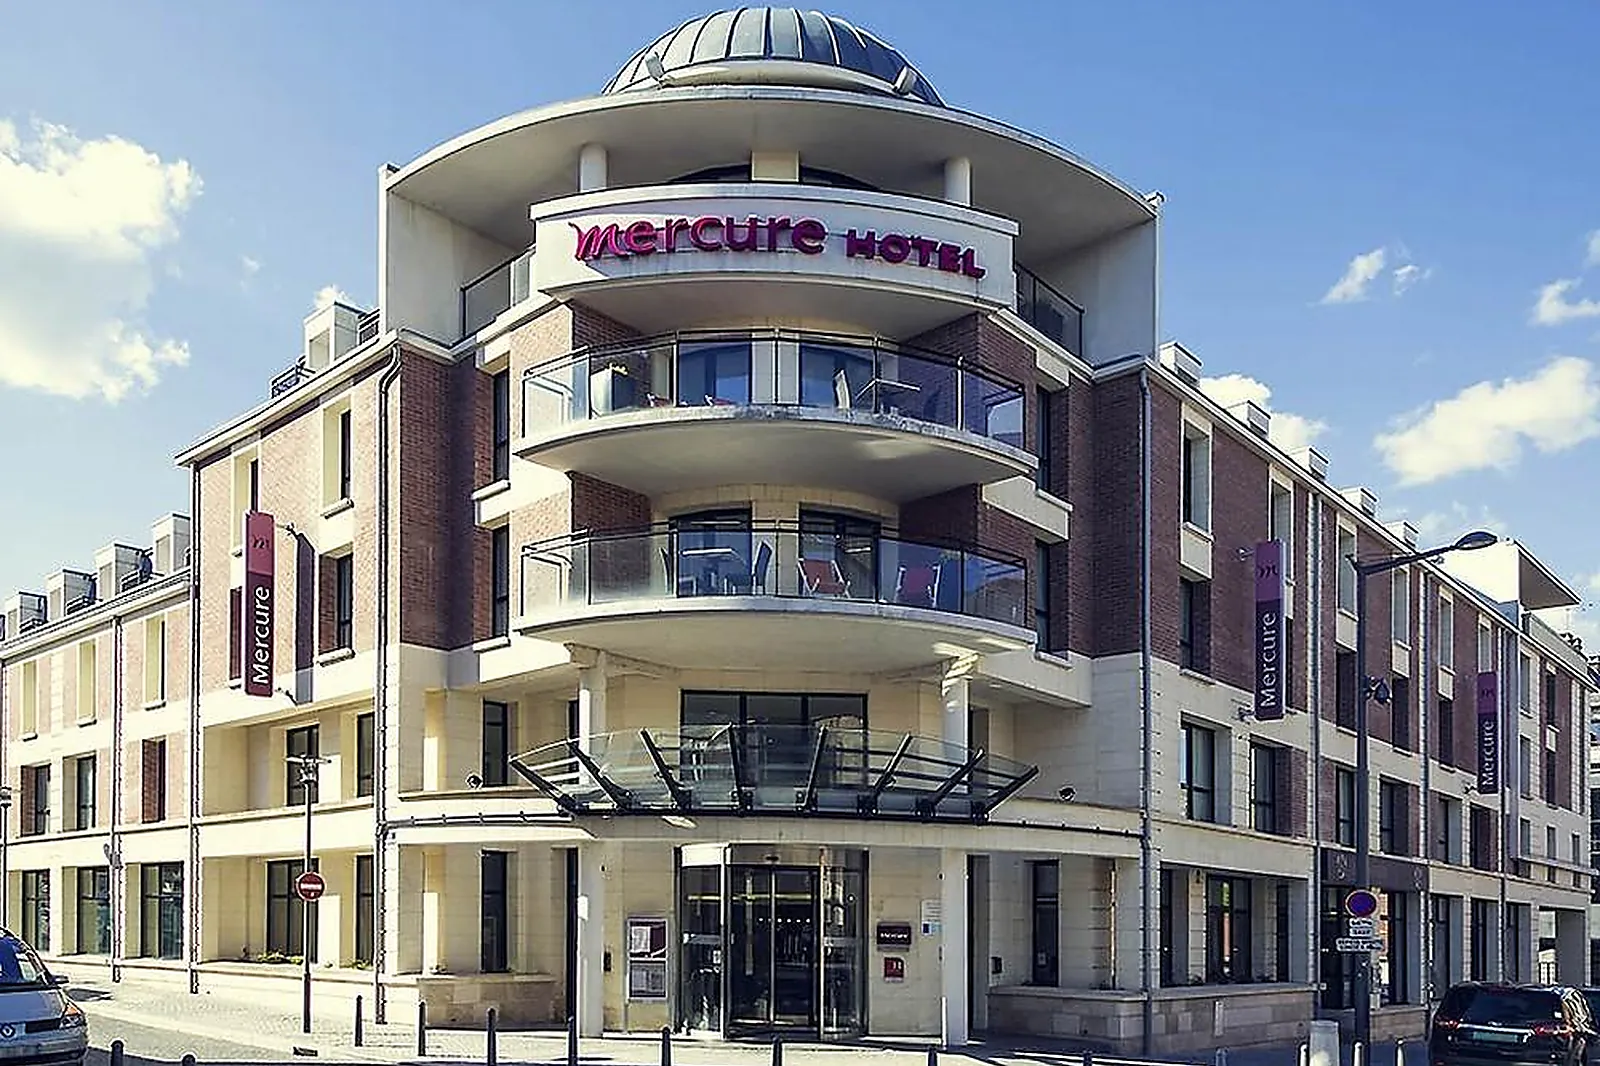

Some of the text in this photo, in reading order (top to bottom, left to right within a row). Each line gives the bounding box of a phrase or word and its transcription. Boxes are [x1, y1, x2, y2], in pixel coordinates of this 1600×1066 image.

[569, 214, 986, 279] mercure HOTEL
[253, 586, 271, 684] Mercure
[1260, 611, 1277, 707] Mercure
[1482, 720, 1495, 785] Mercure
